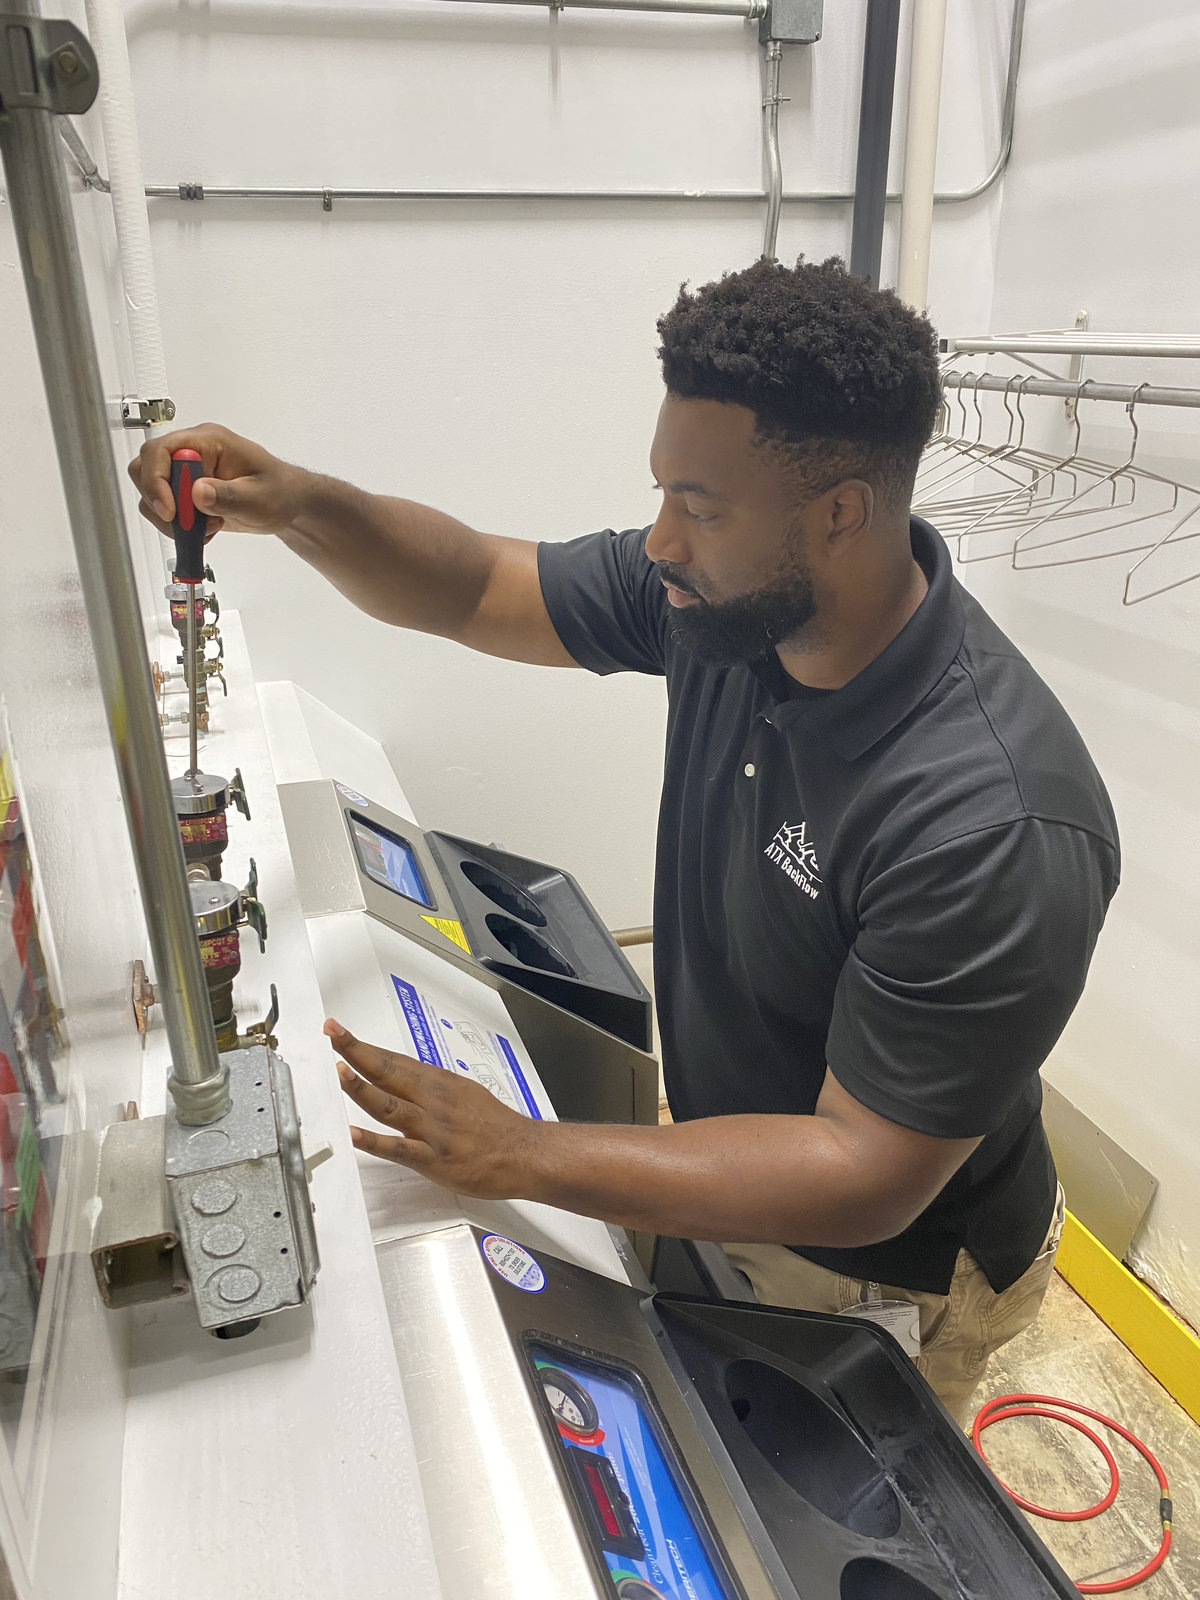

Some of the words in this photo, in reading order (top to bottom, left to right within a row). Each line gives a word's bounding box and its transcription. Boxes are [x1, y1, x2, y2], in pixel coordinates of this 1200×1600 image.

[763, 842, 786, 865] ATX
[406, 1010, 434, 1063] HANDWASHING
[493, 1245, 503, 1254] CALL
[666, 1538, 697, 1600] ERITECH
